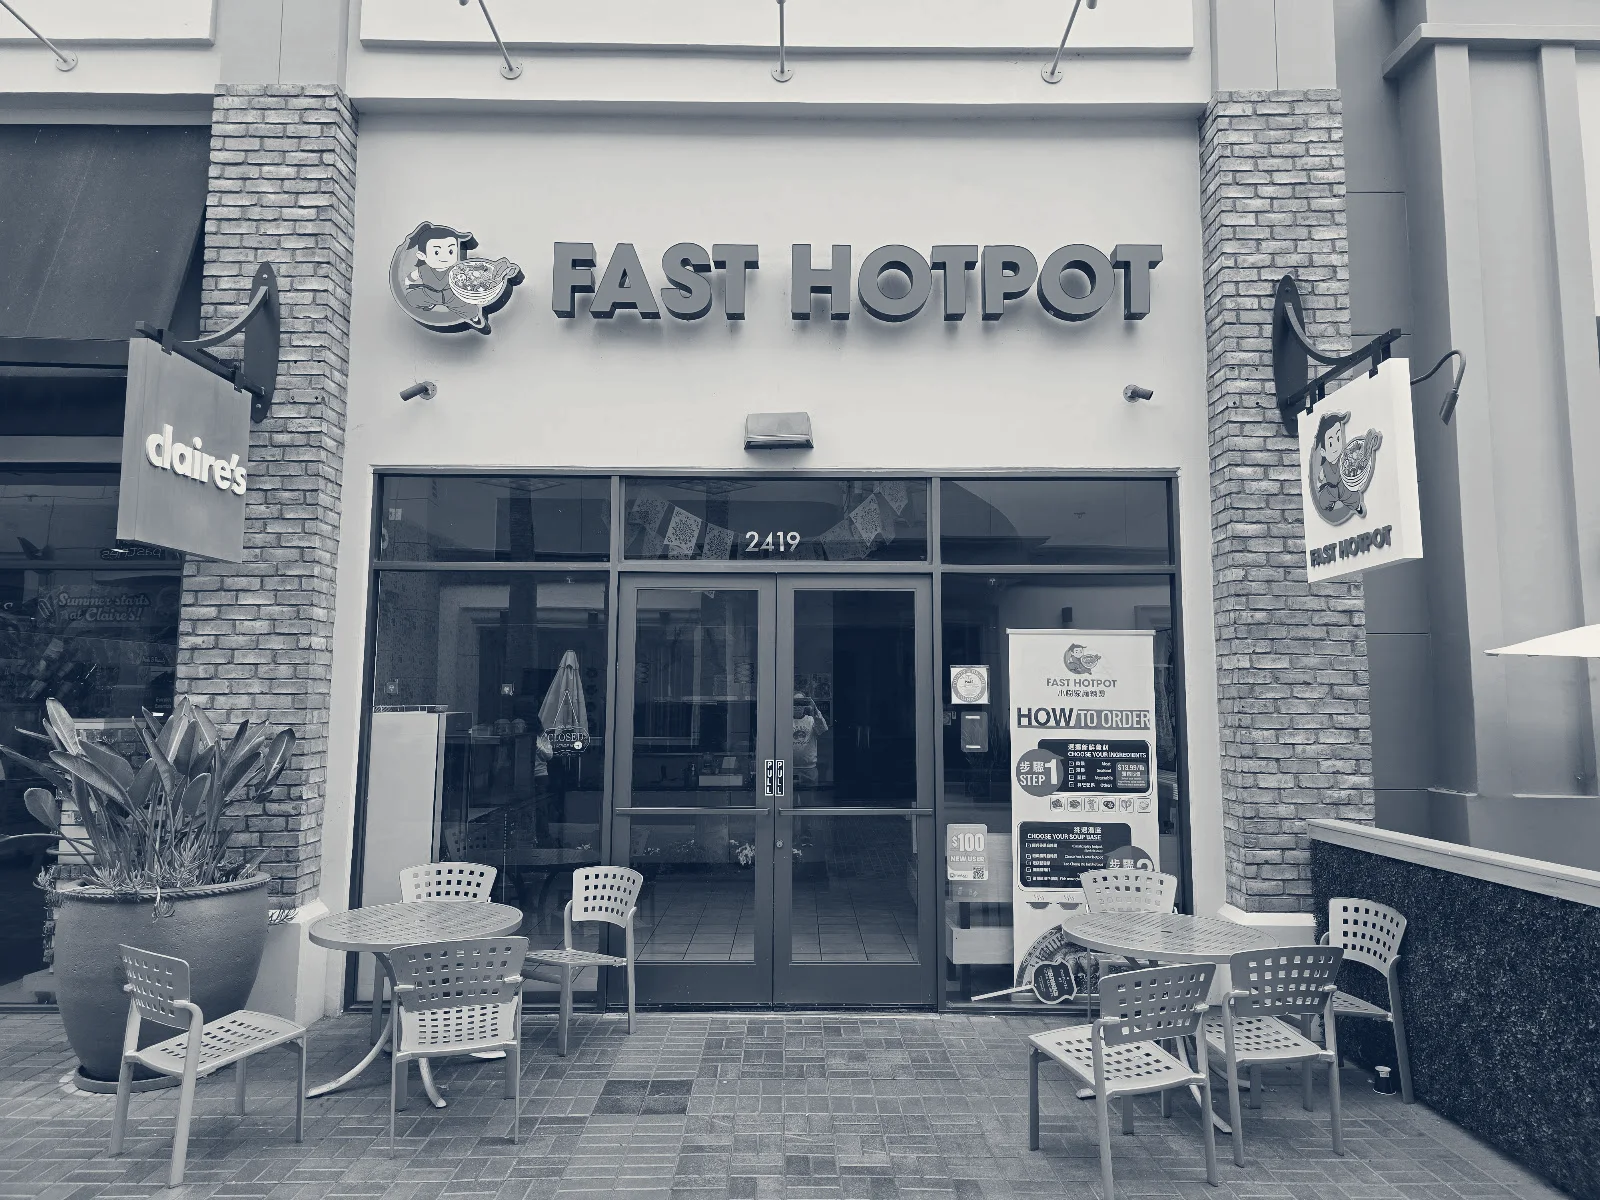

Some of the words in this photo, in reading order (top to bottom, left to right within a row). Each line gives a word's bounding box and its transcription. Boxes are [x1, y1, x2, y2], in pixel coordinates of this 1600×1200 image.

[551, 241, 760, 321] FAST
[791, 243, 1164, 323] HOTPOT
[145, 423, 247, 496] claire's
[744, 531, 801, 552] 2419
[1309, 542, 1338, 568] FAST
[1338, 524, 1393, 560] HOTPOT
[58, 592, 112, 606] Summer
[114, 594, 150, 606] starts
[69, 608, 83, 621] at
[85, 607, 143, 622] Claire's!
[1046, 678, 1071, 687] FAST
[1073, 678, 1118, 688] HOTPOT
[1016, 707, 1074, 727] HOW
[1077, 710, 1097, 727] TO
[1101, 710, 1150, 728] ORDER
[547, 732, 584, 742] CLOSED
[1019, 774, 1046, 786] STEP
[1044, 758, 1058, 785] 1
[951, 833, 985, 851] $100
